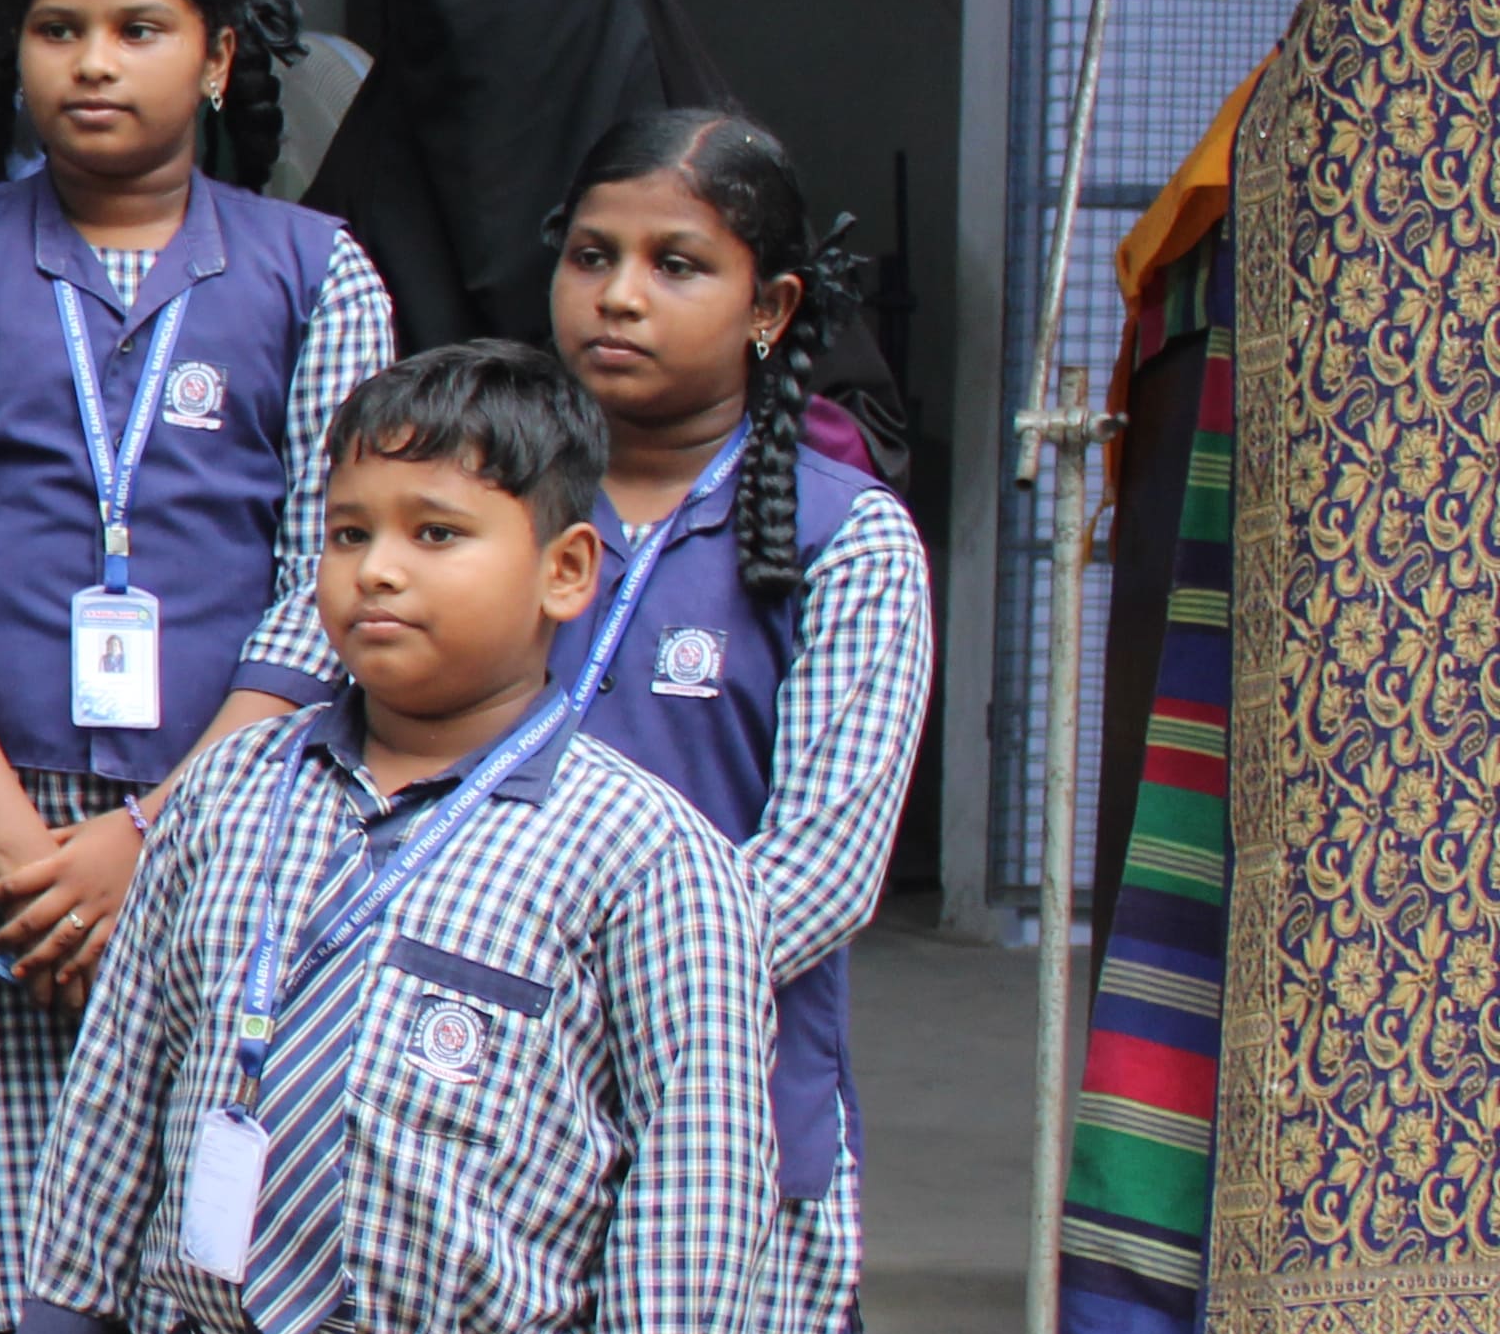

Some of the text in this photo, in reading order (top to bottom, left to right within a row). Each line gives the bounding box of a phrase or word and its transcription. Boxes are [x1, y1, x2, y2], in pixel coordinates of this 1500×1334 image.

[134, 372, 160, 434] MEMORIAL
[123, 429, 143, 469] RAHIM
[115, 466, 133, 515] ABDUL
[577, 665, 601, 705] RAHIM
[594, 602, 629, 663] MEMORIAL
[317, 920, 356, 959] RAHIM
[350, 866, 407, 923] MEMORIAL
[402, 794, 474, 871] MATRICULATION
[474, 752, 518, 795] SCHOOL
[256, 939, 275, 983] ABDUL
